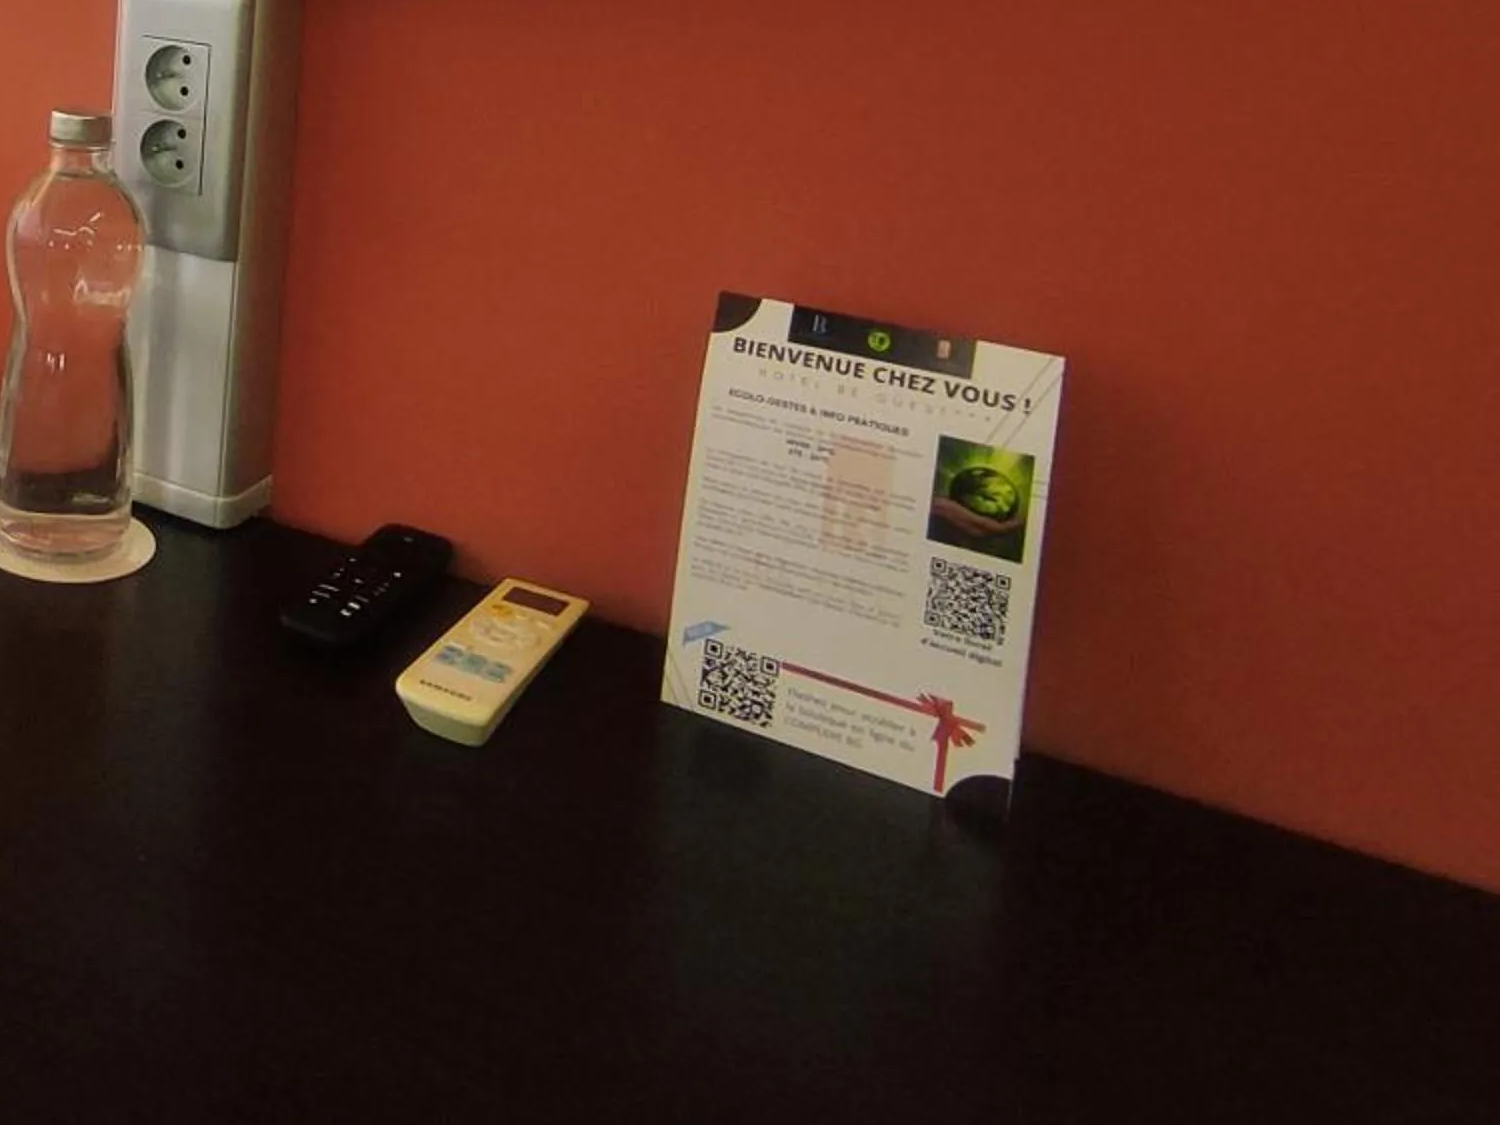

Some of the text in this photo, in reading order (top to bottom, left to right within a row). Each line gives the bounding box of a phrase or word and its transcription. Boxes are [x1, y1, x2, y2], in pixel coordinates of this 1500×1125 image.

[732, 336, 1032, 415] BIENVENUE CHEZ VOUS !
